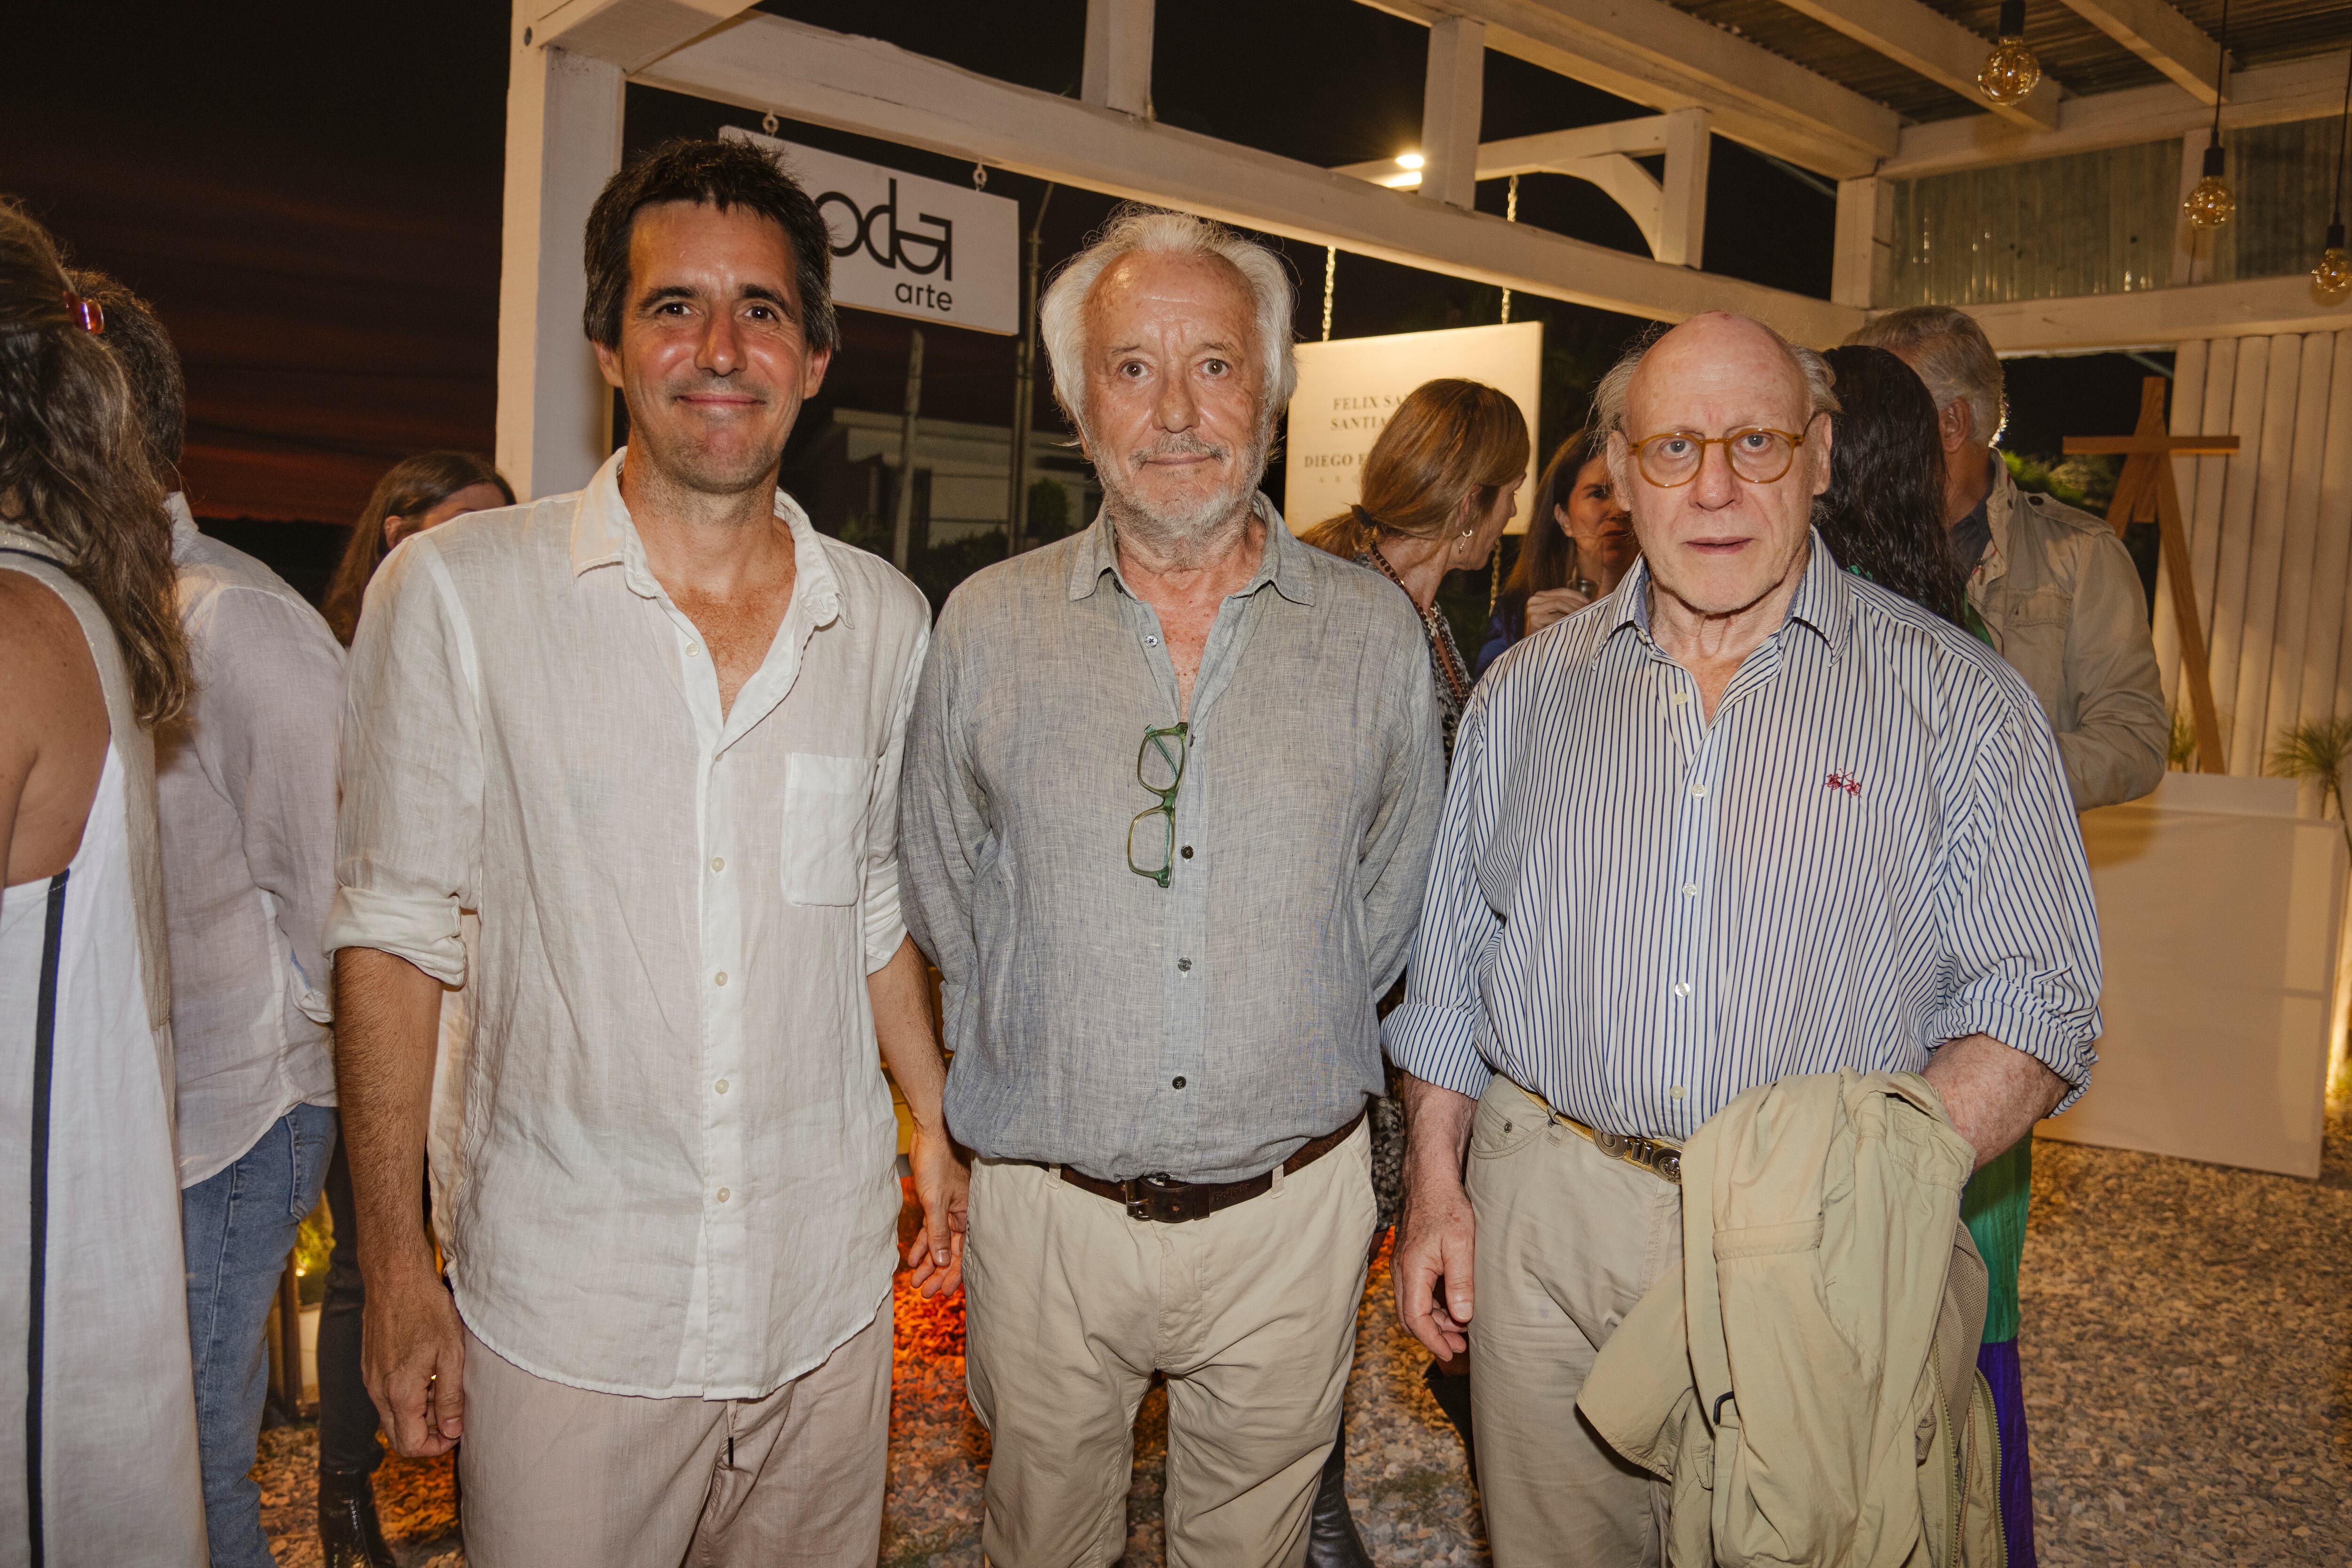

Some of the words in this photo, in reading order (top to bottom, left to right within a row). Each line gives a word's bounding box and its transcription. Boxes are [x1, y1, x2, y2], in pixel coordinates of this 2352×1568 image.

[895, 283, 953, 312] arte
[1333, 396, 1378, 410] FELIX
[1304, 453, 1353, 468] DIEGO
